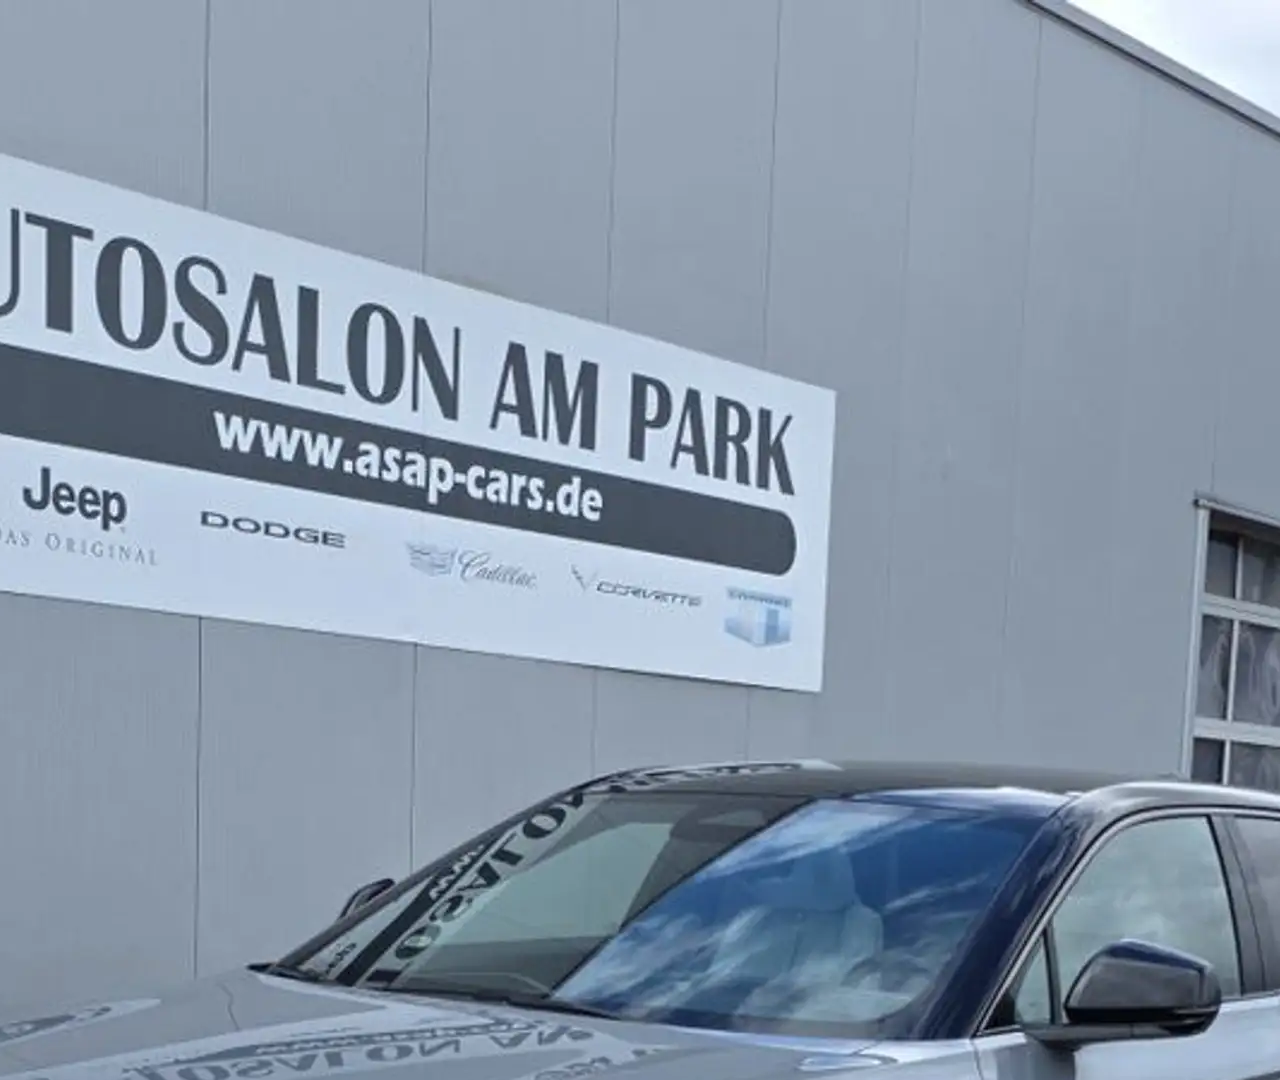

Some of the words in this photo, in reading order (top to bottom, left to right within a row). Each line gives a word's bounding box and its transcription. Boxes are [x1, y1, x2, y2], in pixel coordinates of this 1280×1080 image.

[489, 340, 600, 451] AM
[627, 371, 796, 496] PARK
[214, 410, 604, 521] www.asap-cars.de
[22, 466, 128, 532] Jeep
[44, 531, 160, 566] ORIGINAL
[199, 510, 346, 549] DODGE
[456, 549, 537, 589] Cadillac
[595, 580, 704, 608] CORVETTE
